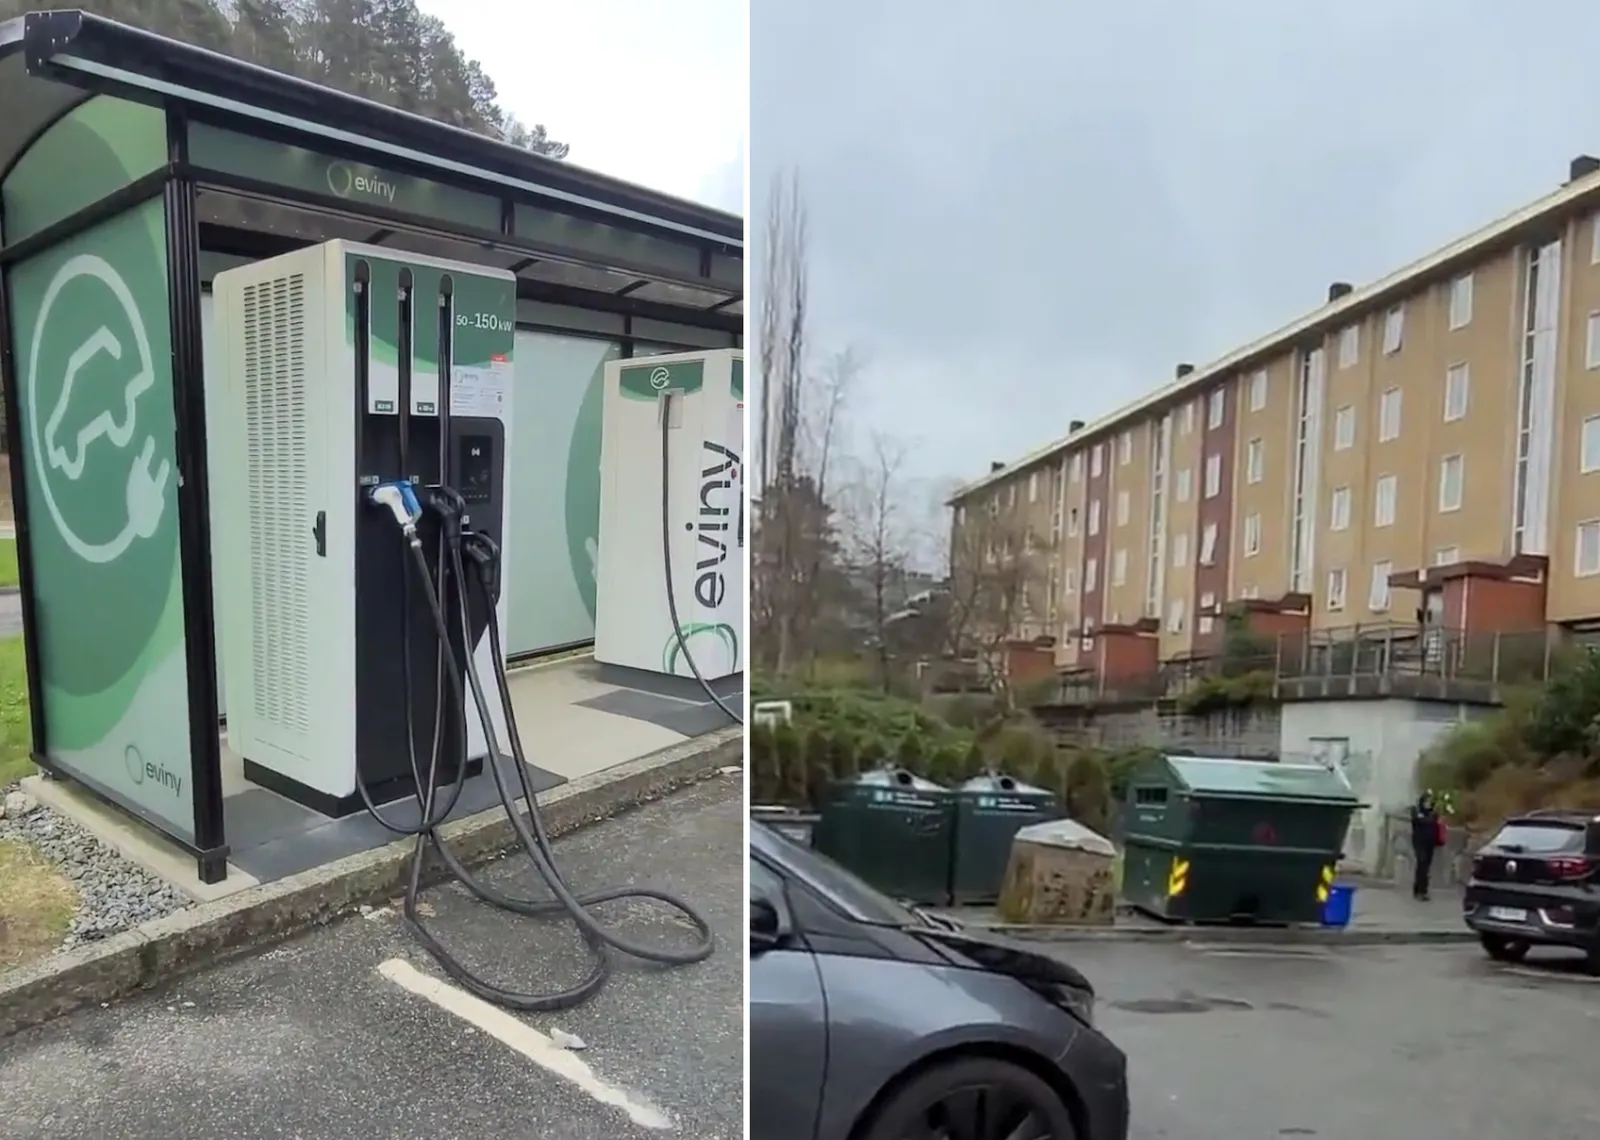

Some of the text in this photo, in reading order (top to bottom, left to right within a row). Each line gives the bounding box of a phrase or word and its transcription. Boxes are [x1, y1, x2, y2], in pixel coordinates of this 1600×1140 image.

[354, 175, 396, 203] eviny
[498, 319, 512, 332] kW
[685, 440, 740, 609] eviny
[146, 762, 181, 798] eviny
